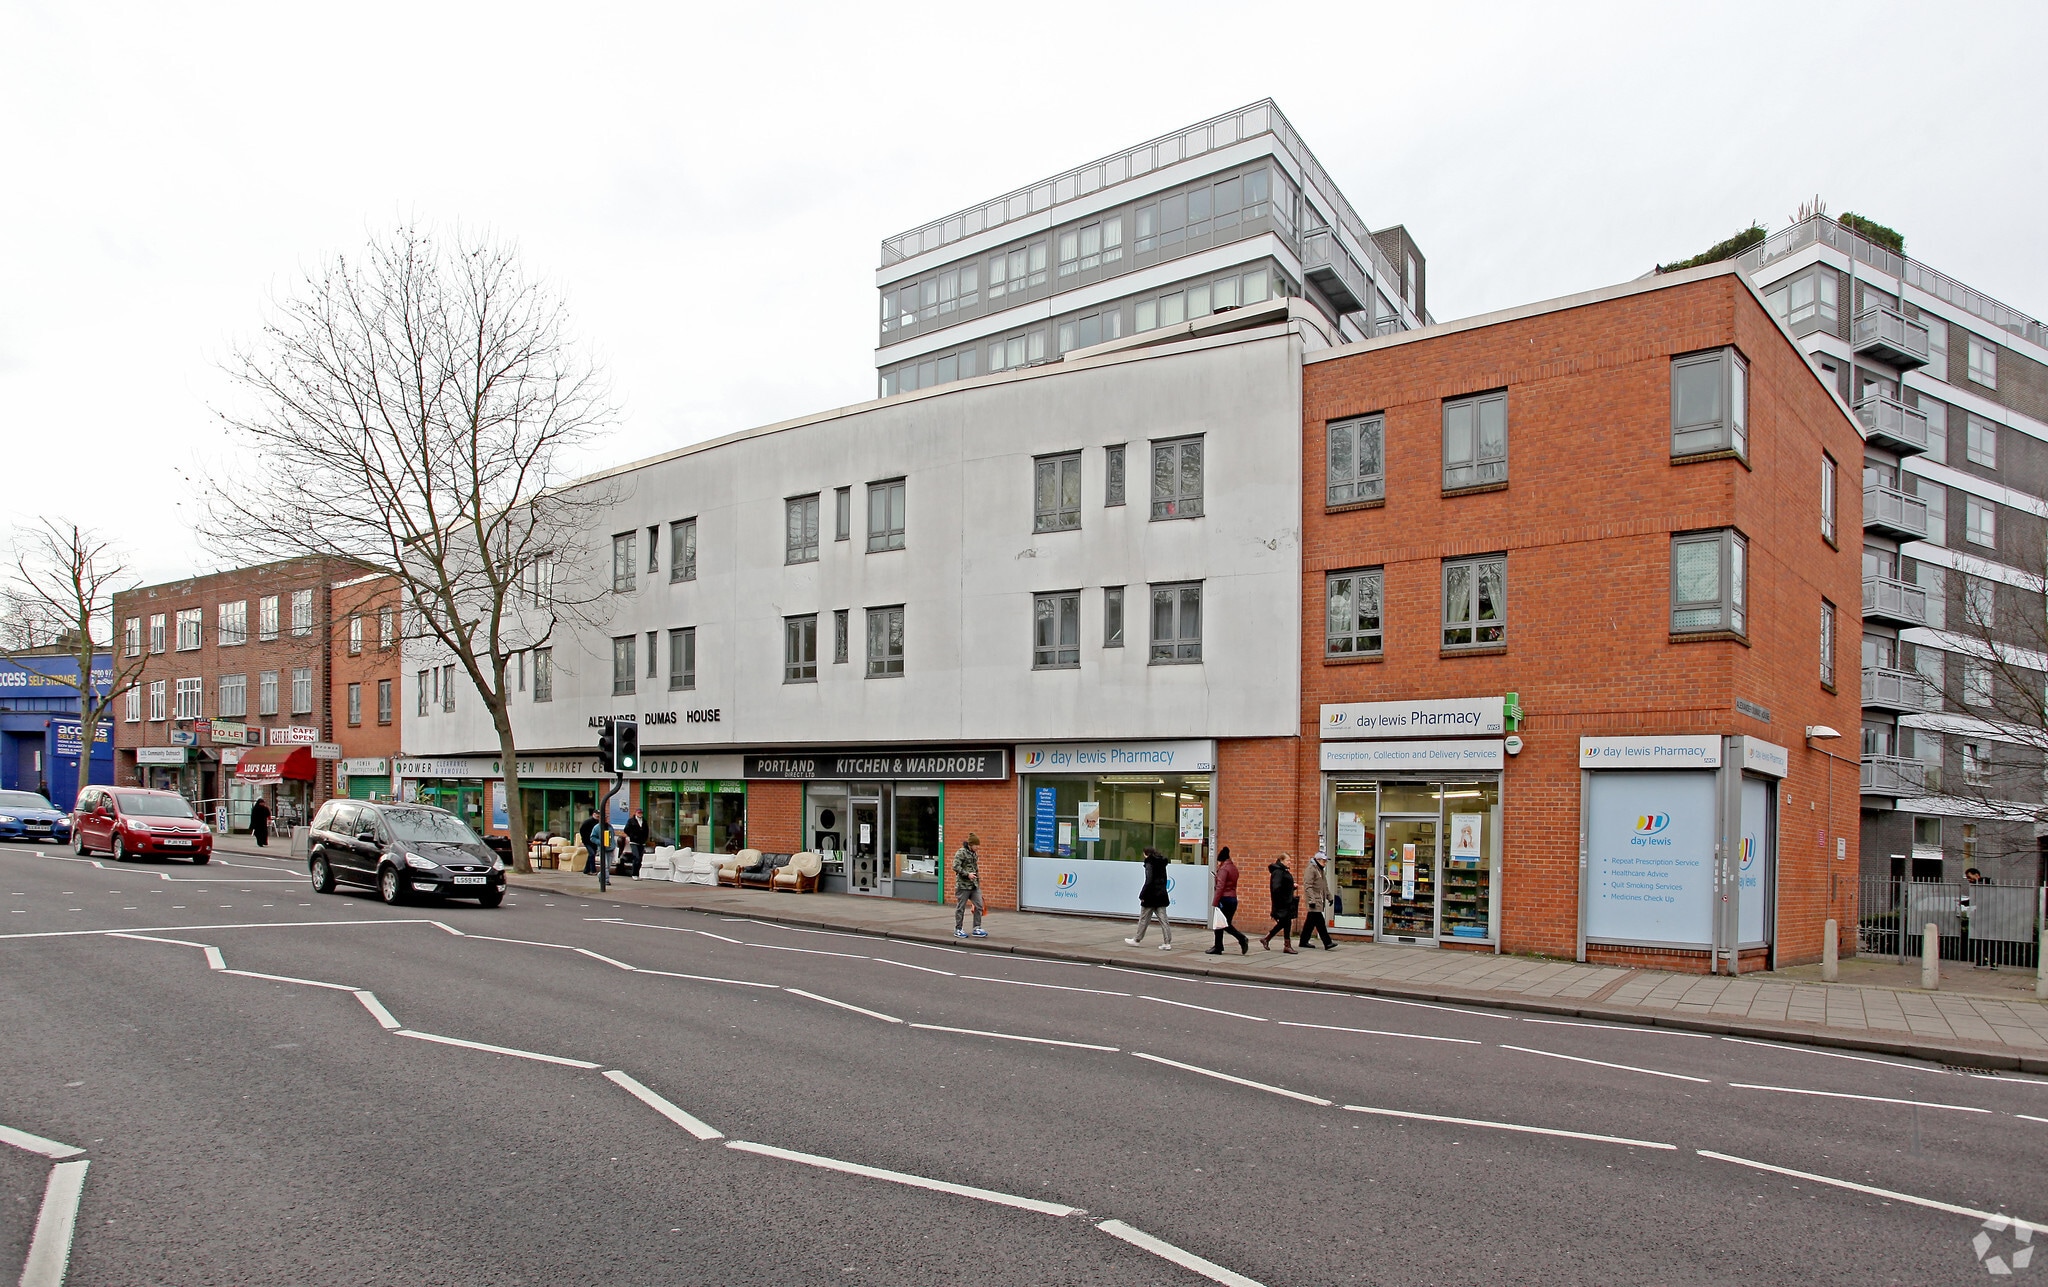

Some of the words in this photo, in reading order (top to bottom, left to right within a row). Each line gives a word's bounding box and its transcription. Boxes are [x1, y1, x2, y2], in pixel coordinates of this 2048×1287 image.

[29, 676, 45, 686] SELF
[645, 712, 677, 725] DUMAS
[686, 708, 720, 722] HOUSE
[1356, 716, 1376, 729] day
[1378, 715, 1406, 726] lewis
[1411, 711, 1481, 726] Pharmacy
[58, 725, 107, 737] accss
[1327, 752, 1371, 760] Prescription,
[1374, 751, 1410, 759] Collection
[1412, 751, 1426, 759] and
[1429, 750, 1460, 759] Delivery
[1463, 750, 1496, 758] Services
[1604, 747, 1621, 758] day
[1625, 747, 1650, 756] lewis
[1654, 746, 1706, 757] Pharmacy
[1051, 750, 1072, 767] day
[1076, 750, 1106, 763] lewis
[1111, 749, 1174, 765] Pharmacy
[244, 764, 260, 772] LOU'S
[261, 764, 276, 773] CAFE
[403, 763, 432, 772] POWER
[501, 762, 534, 773] EEN
[545, 762, 582, 773] MARKET
[643, 760, 699, 773] LONDON
[758, 760, 815, 772] PORTLAND
[836, 759, 890, 773] KITCHEN
[893, 759, 902, 772] &
[906, 757, 985, 772] WARDROBE
[1631, 837, 1646, 846] day
[1649, 837, 1671, 846] lewis
[1636, 858, 1673, 866] Prescription
[1627, 882, 1654, 890] Smoking
[1055, 890, 1064, 898] day
[1065, 890, 1078, 898] lewis
